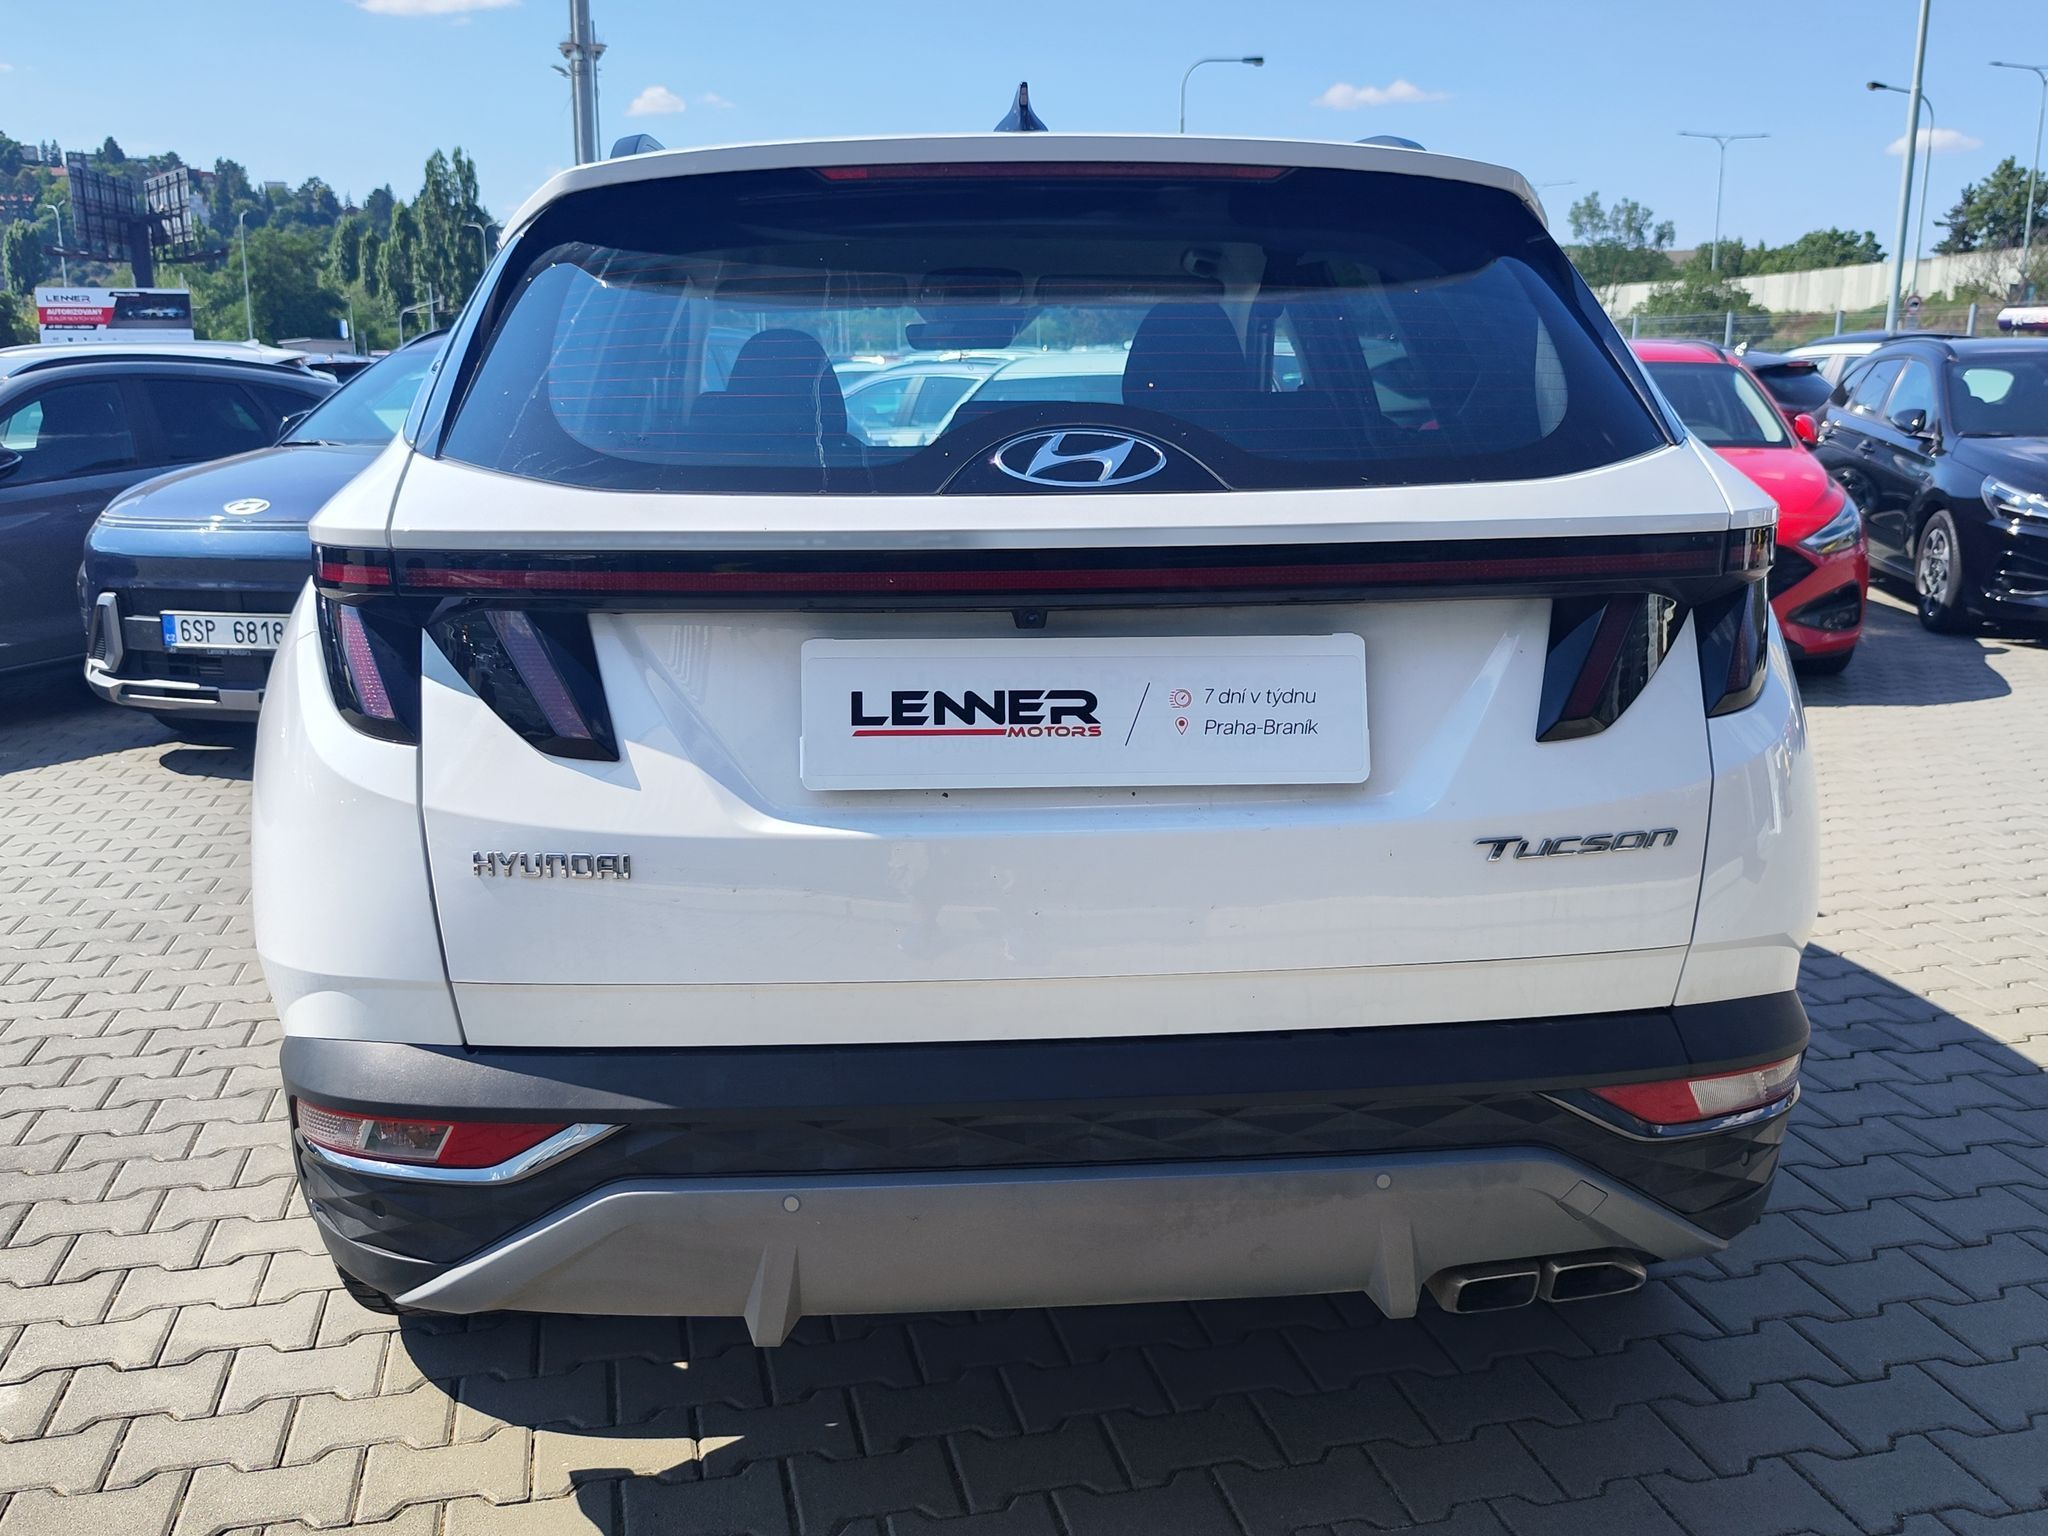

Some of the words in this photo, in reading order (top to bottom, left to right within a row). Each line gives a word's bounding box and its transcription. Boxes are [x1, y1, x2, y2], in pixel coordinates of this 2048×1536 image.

[45, 295, 90, 303] LENNER
[180, 619, 215, 643] 6SP
[233, 620, 283, 645] 6818
[851, 690, 1101, 725] LENNER
[1204, 688, 1215, 704] 7
[1218, 688, 1247, 704] dní
[1250, 691, 1261, 704] v
[1266, 688, 1317, 708] týdnu
[1008, 726, 1101, 737] MOTORS
[1204, 719, 1318, 735] Praha-Braník
[472, 850, 631, 880] HYUNDAI
